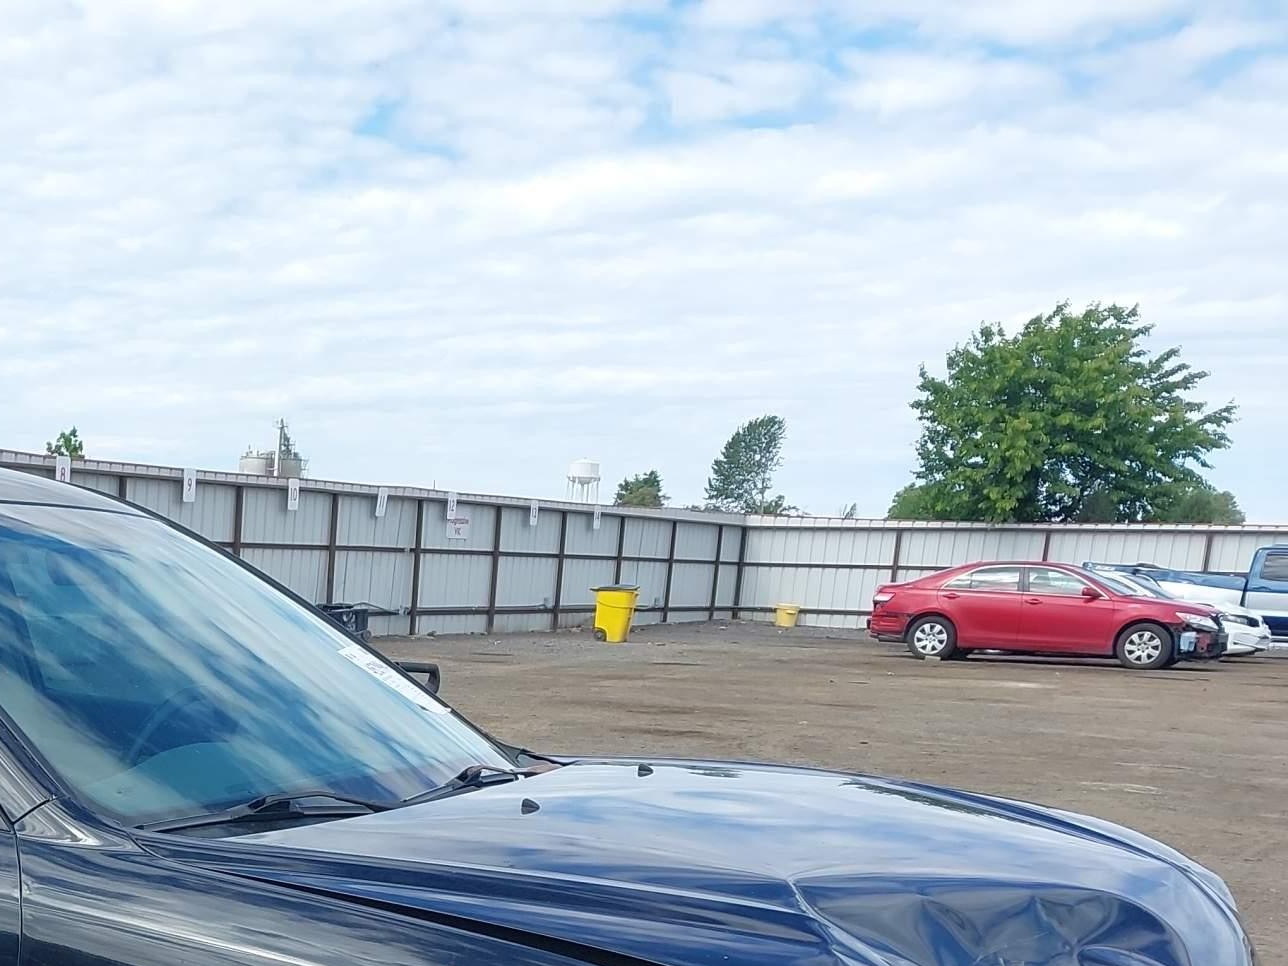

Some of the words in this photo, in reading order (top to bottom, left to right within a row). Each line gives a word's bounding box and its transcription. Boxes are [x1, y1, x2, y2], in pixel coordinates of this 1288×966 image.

[187, 477, 192, 492] 9
[290, 487, 297, 501] 10
[379, 495, 386, 509] 11
[449, 499, 455, 511] 12
